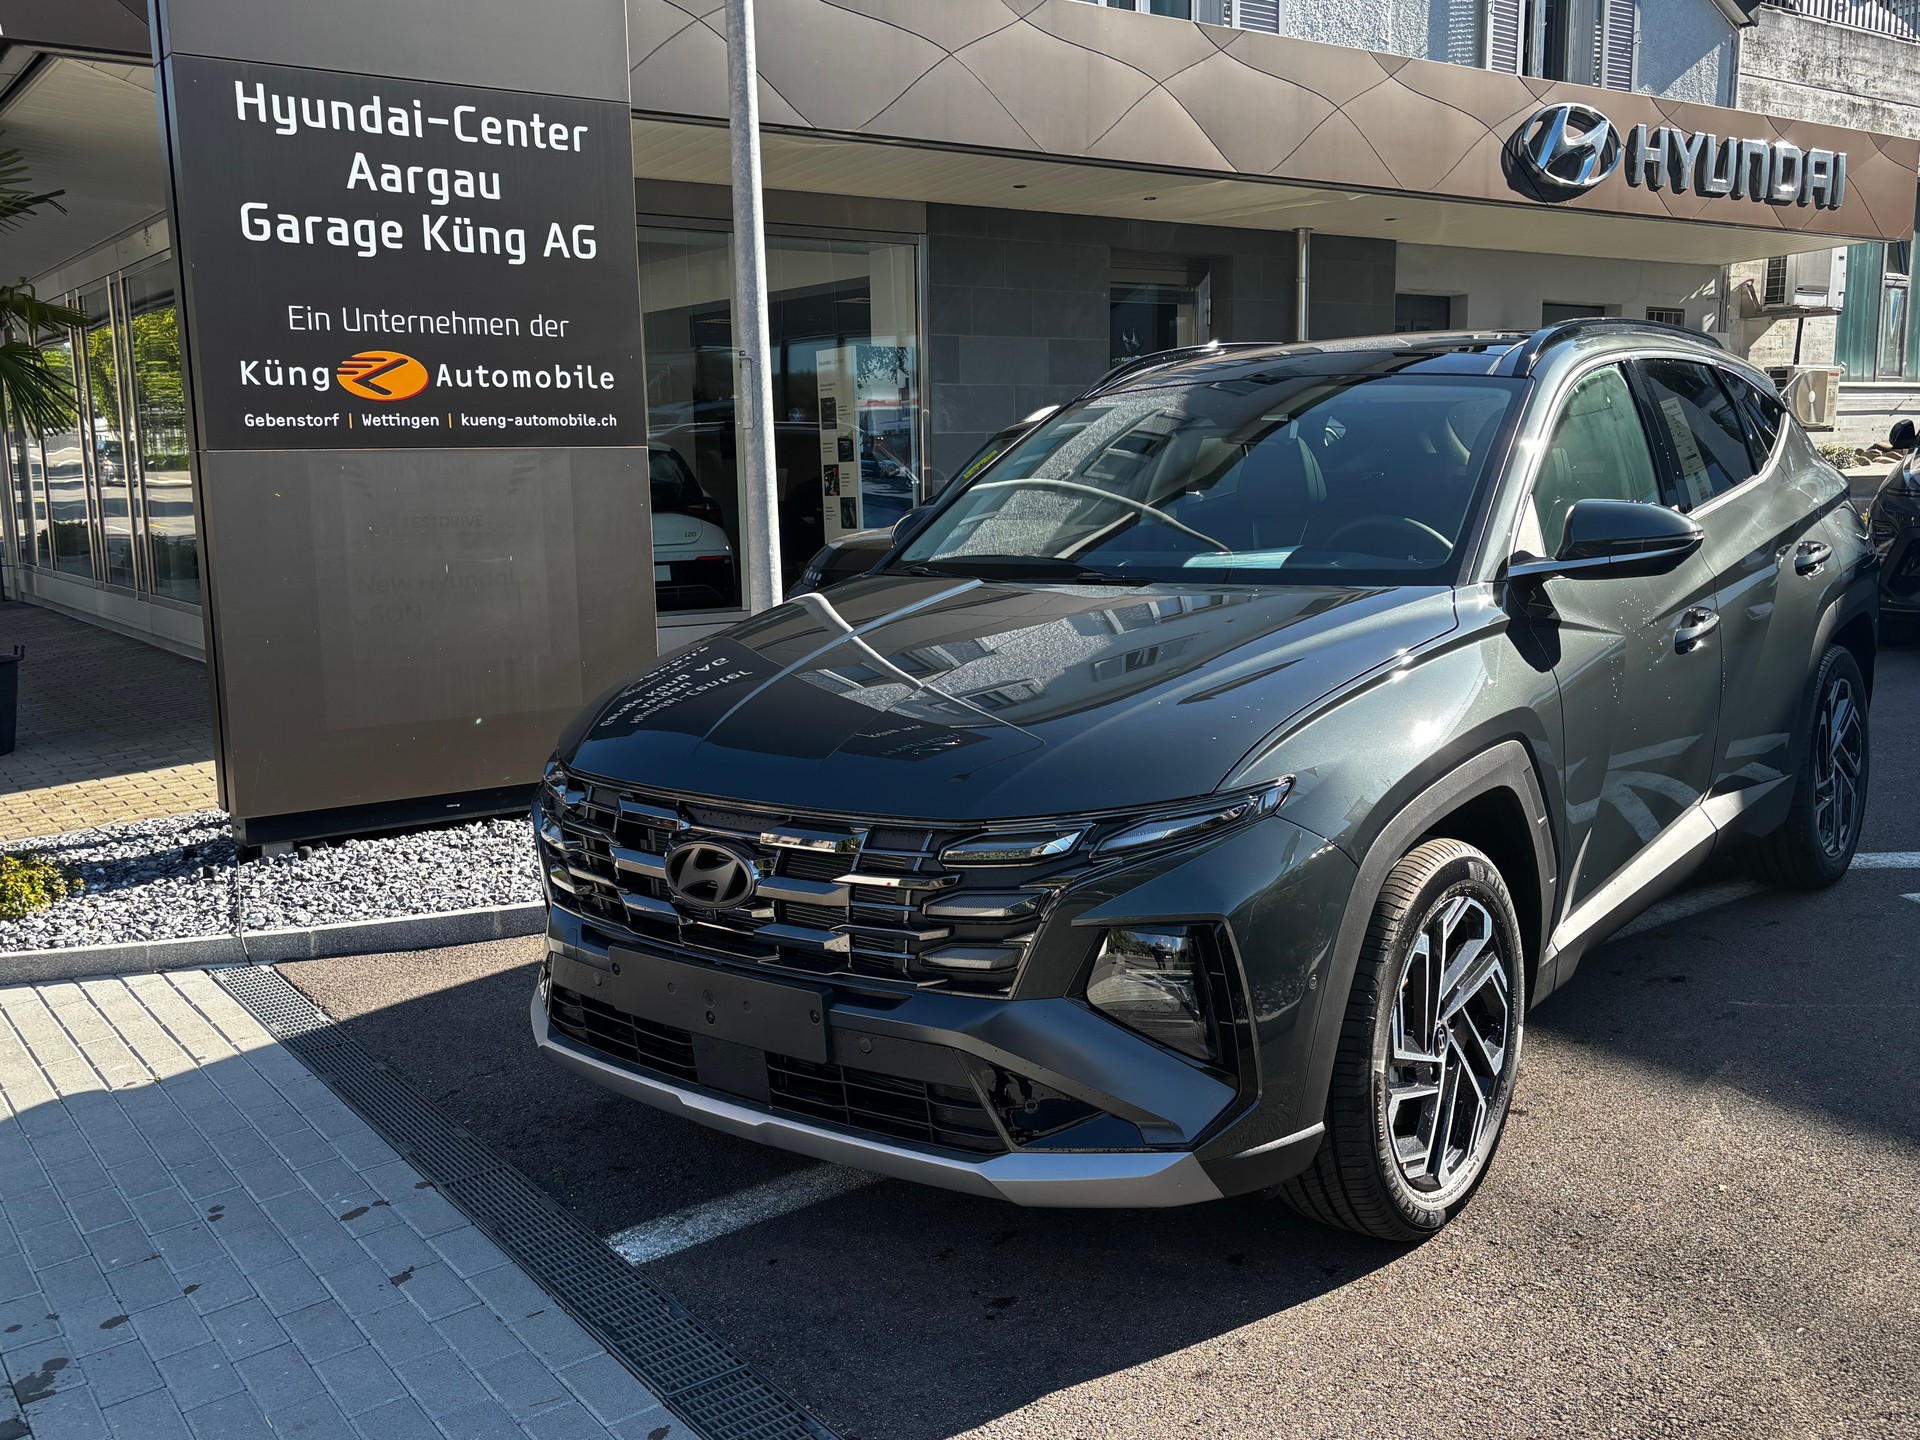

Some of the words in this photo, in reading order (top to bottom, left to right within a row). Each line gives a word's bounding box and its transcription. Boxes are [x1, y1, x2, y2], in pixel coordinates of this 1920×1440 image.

[234, 81, 588, 152] Hyundai-Center
[346, 152, 501, 205] Aargau
[1632, 124, 1848, 208] HYUNDAI
[240, 202, 403, 258] Garage
[422, 214, 527, 264] Küng
[543, 223, 597, 259] AG
[288, 305, 331, 332] Ein
[342, 307, 520, 337] Unternehmen
[530, 314, 570, 338] der
[240, 360, 331, 391] Küng
[436, 363, 615, 389] Automobile
[244, 413, 340, 427] Gebenstorf
[362, 413, 440, 429] Wettingen
[460, 413, 617, 429] kueng-automobile.ch
[1379, 1152, 1428, 1225] MICHELIN
